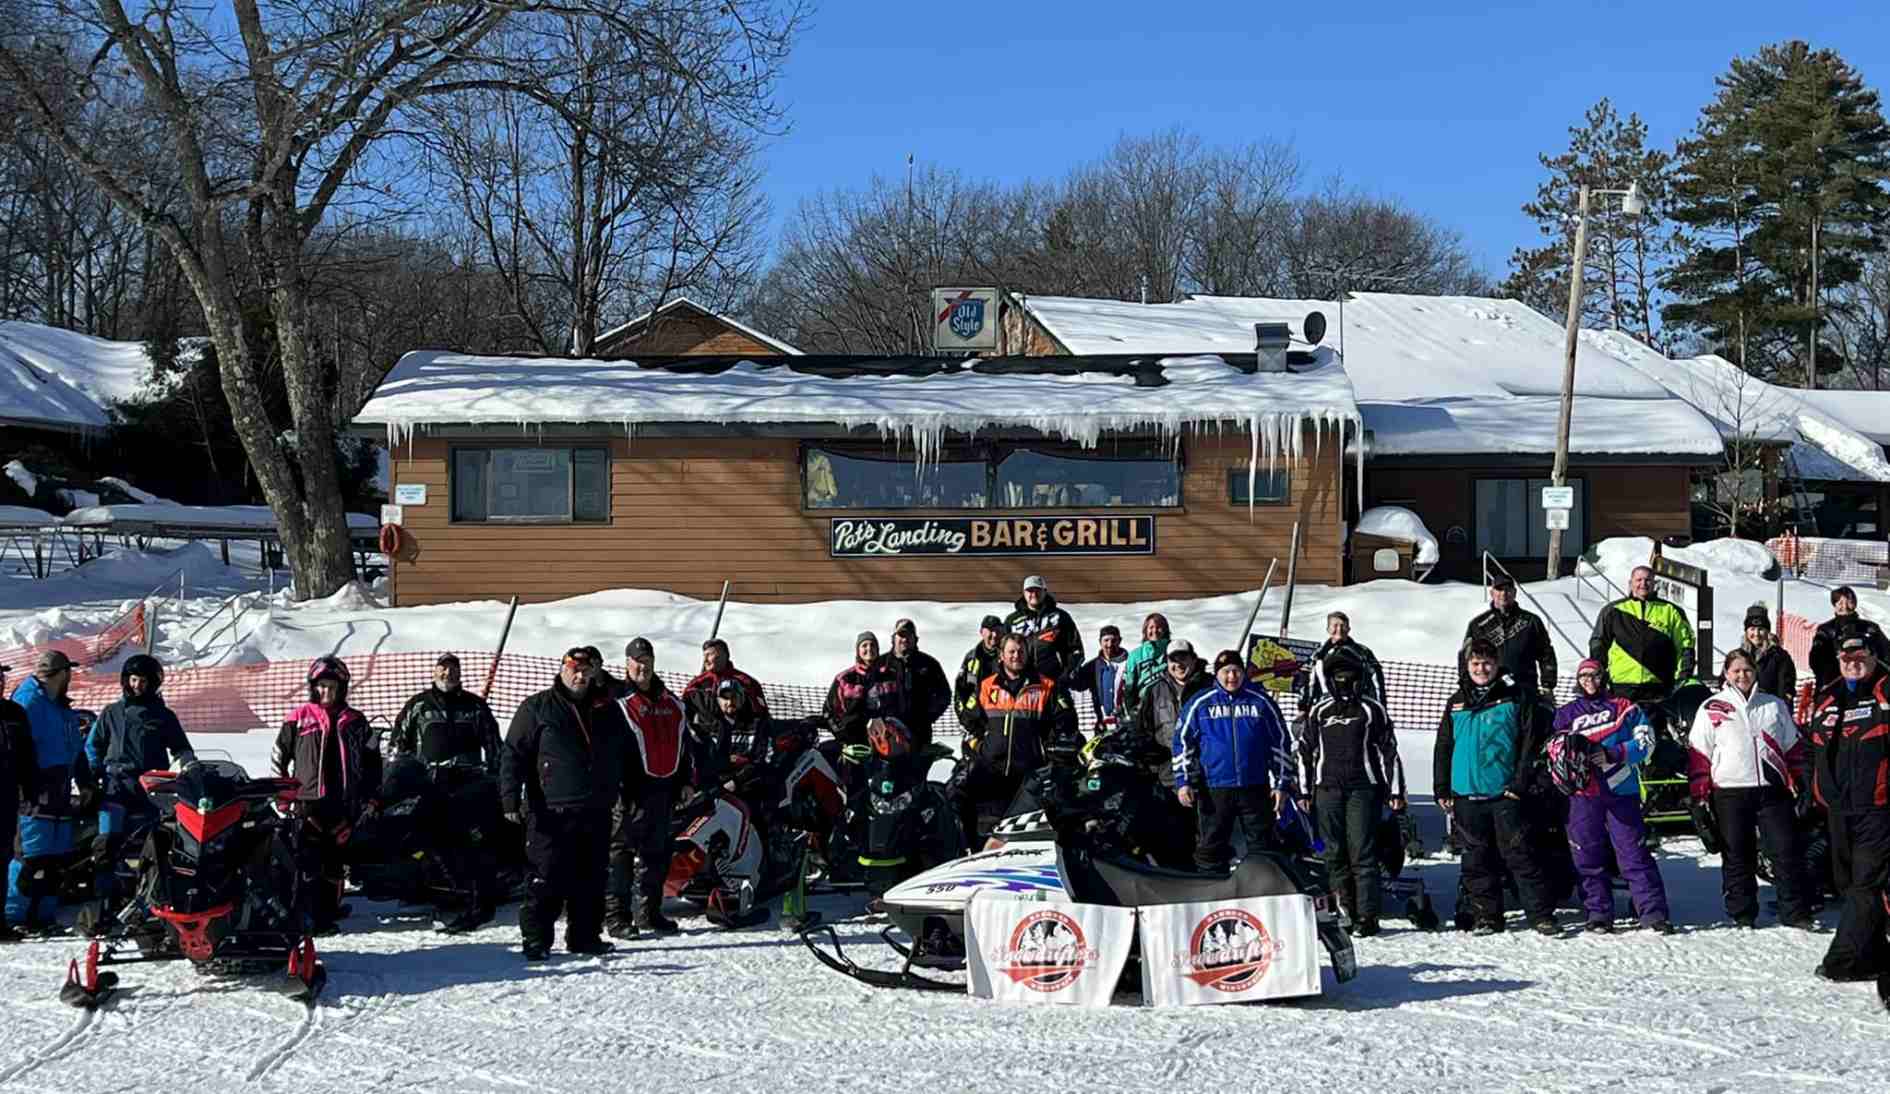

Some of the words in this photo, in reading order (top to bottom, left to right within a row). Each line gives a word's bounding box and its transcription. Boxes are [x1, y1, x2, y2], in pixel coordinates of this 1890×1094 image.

[958, 305, 977, 318] Old
[953, 316, 980, 336] Style
[834, 520, 876, 550] Pat's
[864, 521, 966, 553] Landing
[971, 520, 1034, 547] BAR
[1053, 519, 1147, 546] GRILL
[1208, 704, 1259, 718] YAMAHA
[1572, 710, 1611, 732] FXR
